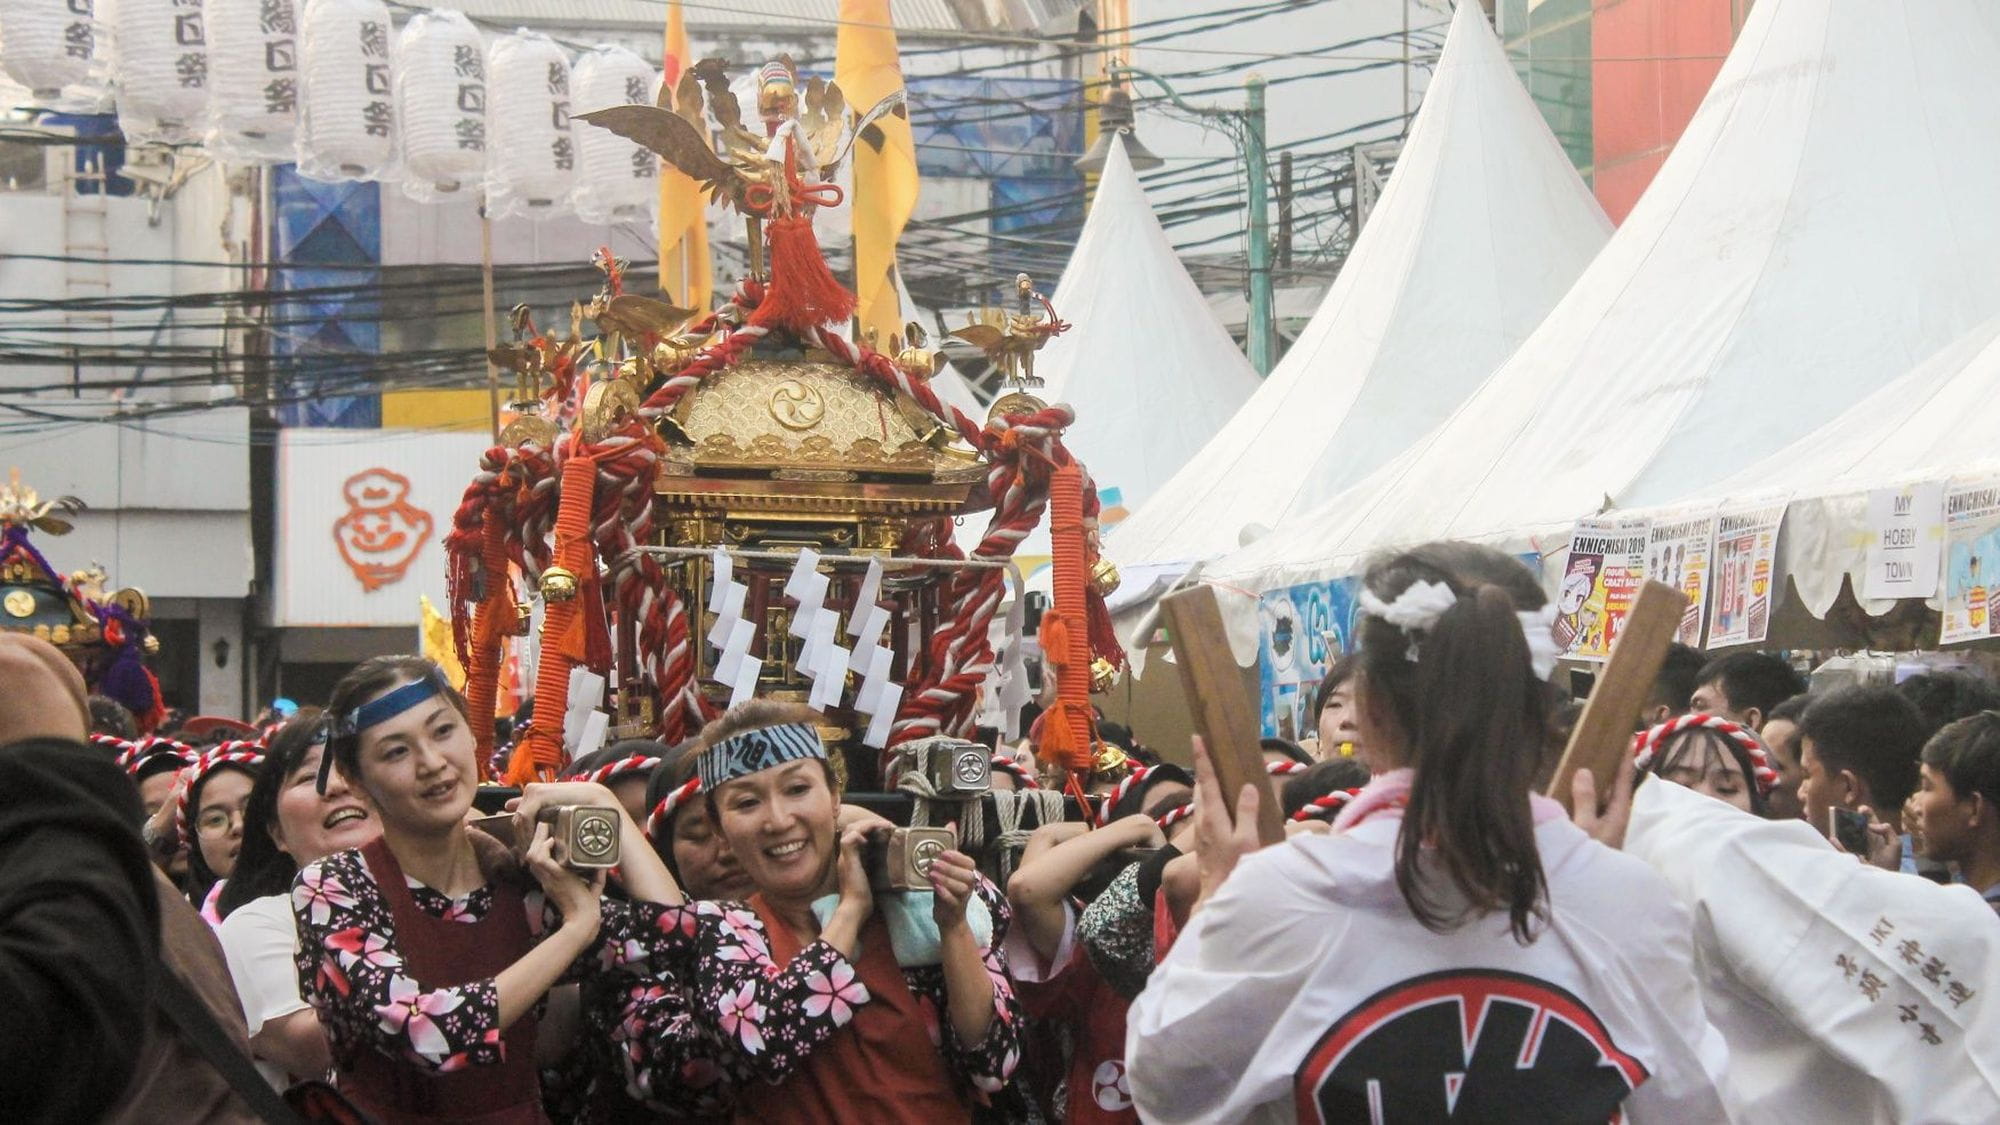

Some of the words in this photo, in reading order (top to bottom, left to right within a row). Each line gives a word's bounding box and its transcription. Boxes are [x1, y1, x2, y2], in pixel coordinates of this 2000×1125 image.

[172, 0, 208, 88] 日祭
[1894, 495, 1913, 513] MY
[1948, 487, 1997, 515] ENNICHISAI
[1651, 522, 1690, 543] ENNICHISAI
[1691, 518, 1711, 537] 2019
[1884, 528, 1917, 545] HOBBY
[1573, 537, 1627, 555] ENNICHISAI
[1628, 537, 1646, 554] 2019
[1885, 561, 1913, 578] TOWN
[1869, 916, 1895, 946] JKT
